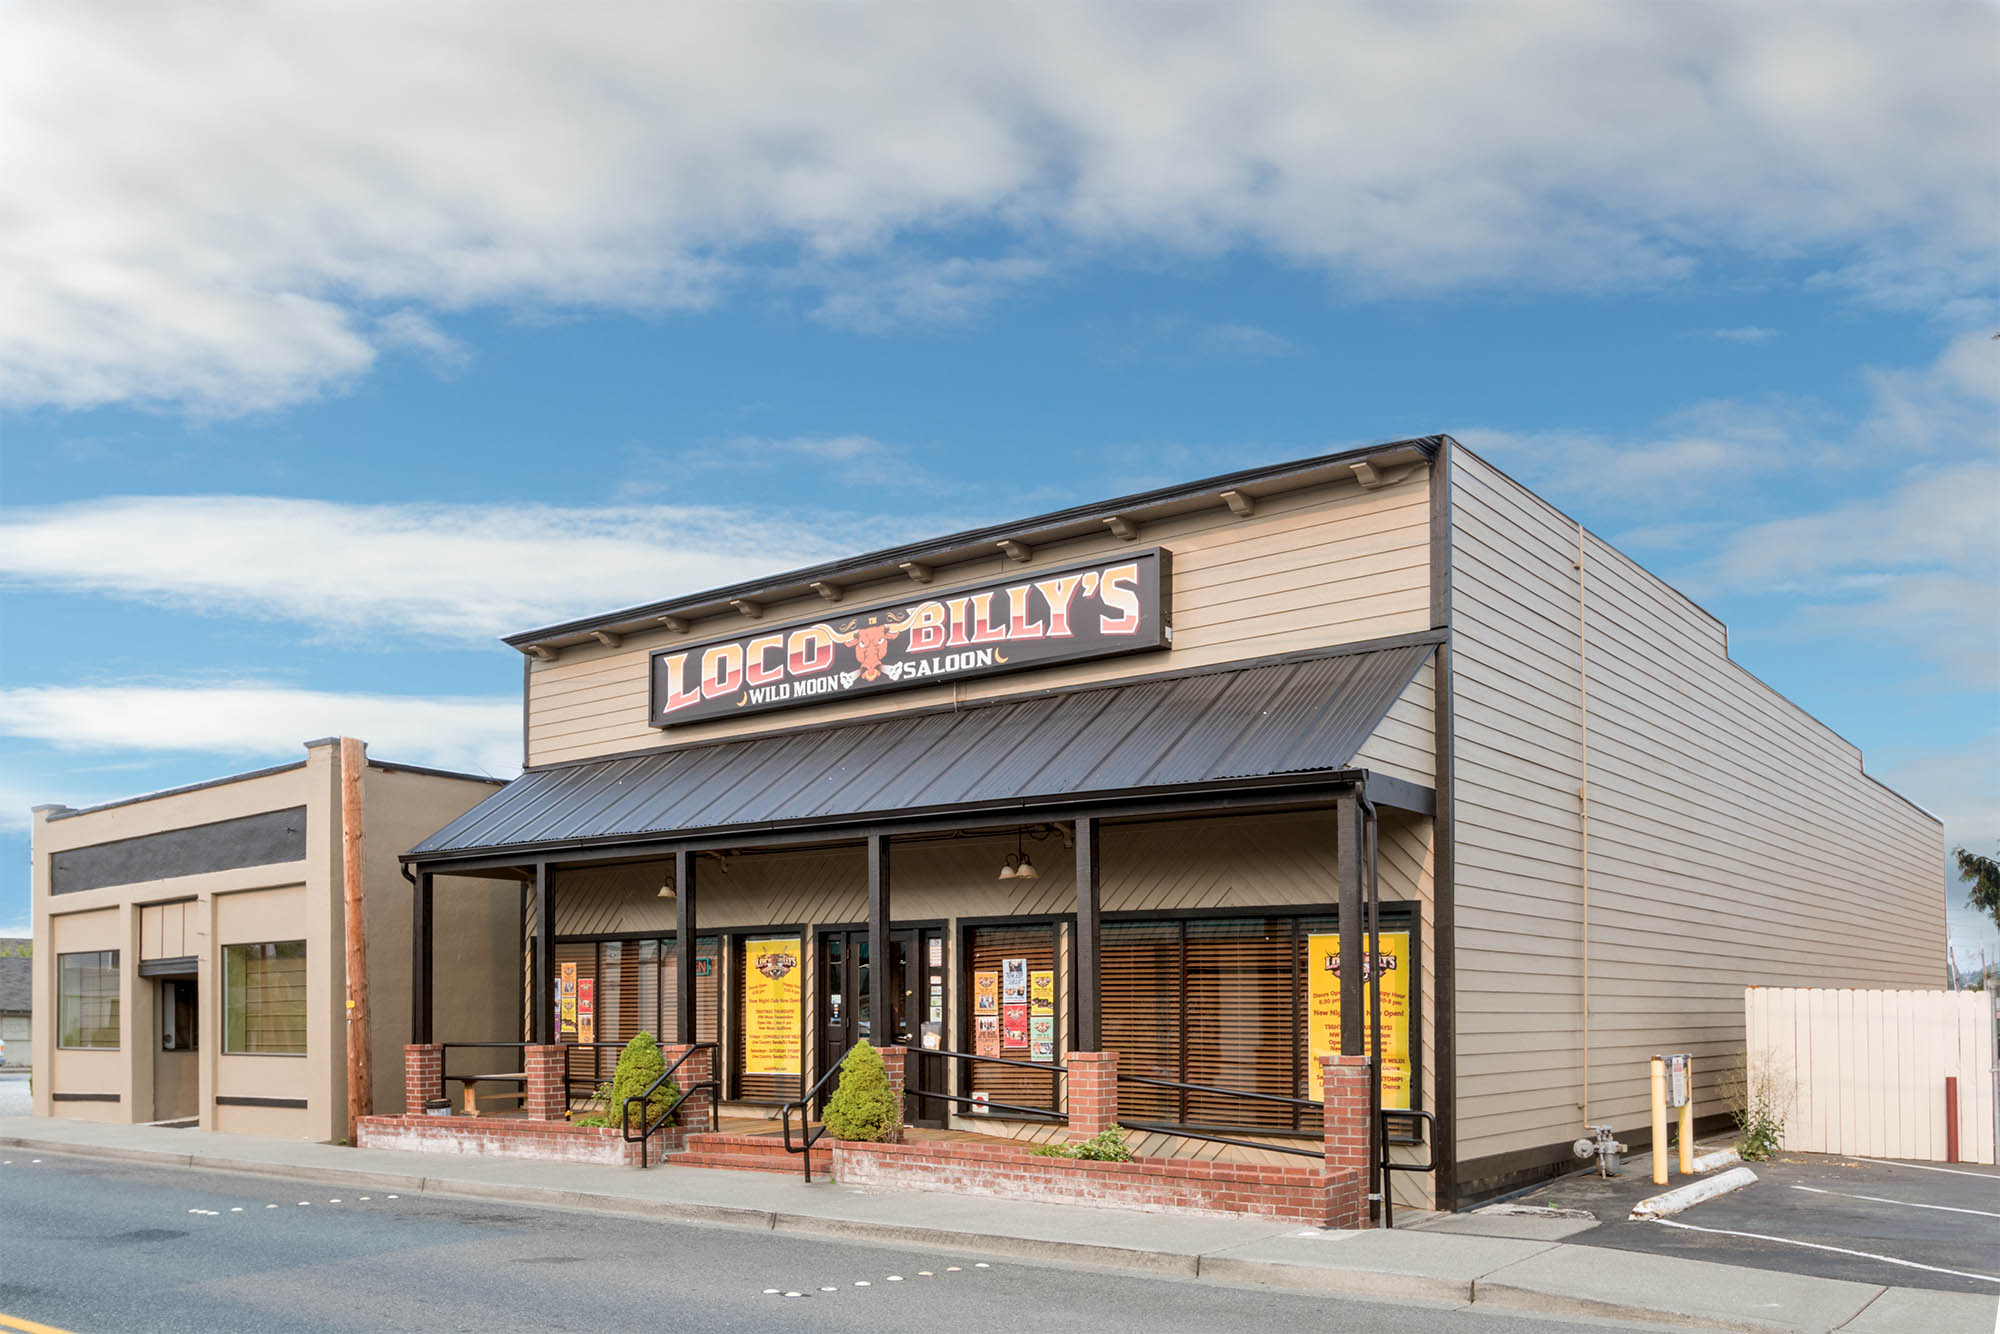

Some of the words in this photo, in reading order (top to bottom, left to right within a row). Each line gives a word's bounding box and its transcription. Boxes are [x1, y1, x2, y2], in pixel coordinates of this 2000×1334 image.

[663, 627, 835, 714] LOCO
[906, 563, 1140, 653] BILLY'S
[903, 648, 994, 679] SALOON
[749, 683, 790, 705] WILD
[793, 674, 839, 697] MOON
